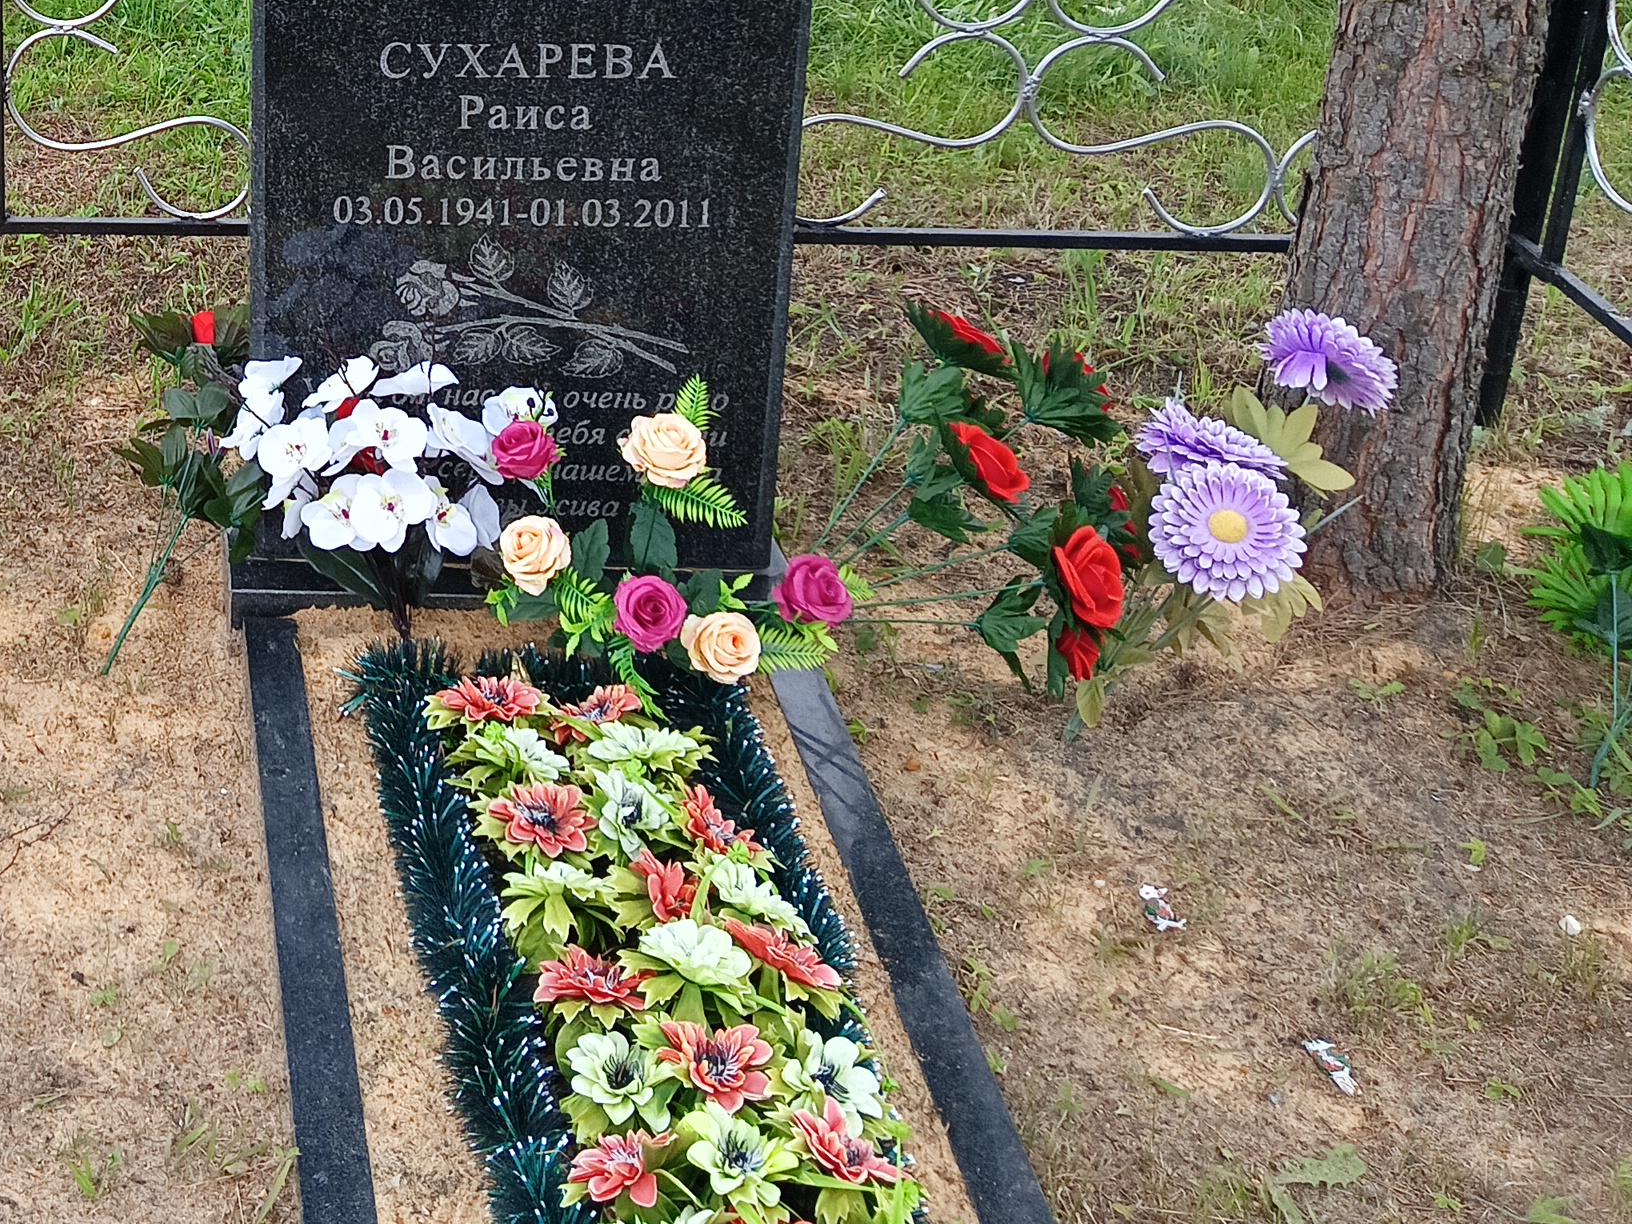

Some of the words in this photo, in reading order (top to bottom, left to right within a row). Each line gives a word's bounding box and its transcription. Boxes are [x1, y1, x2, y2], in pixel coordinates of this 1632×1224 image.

[379, 42, 678, 80] СУХАРЕВА
[457, 94, 594, 131] Раиса
[384, 144, 663, 183] Васильевна
[332, 195, 712, 229] 03.05.1941-01.03.2011
[562, 389, 649, 410] очень
[655, 391, 731, 416] ро
[548, 418, 607, 446] ебя
